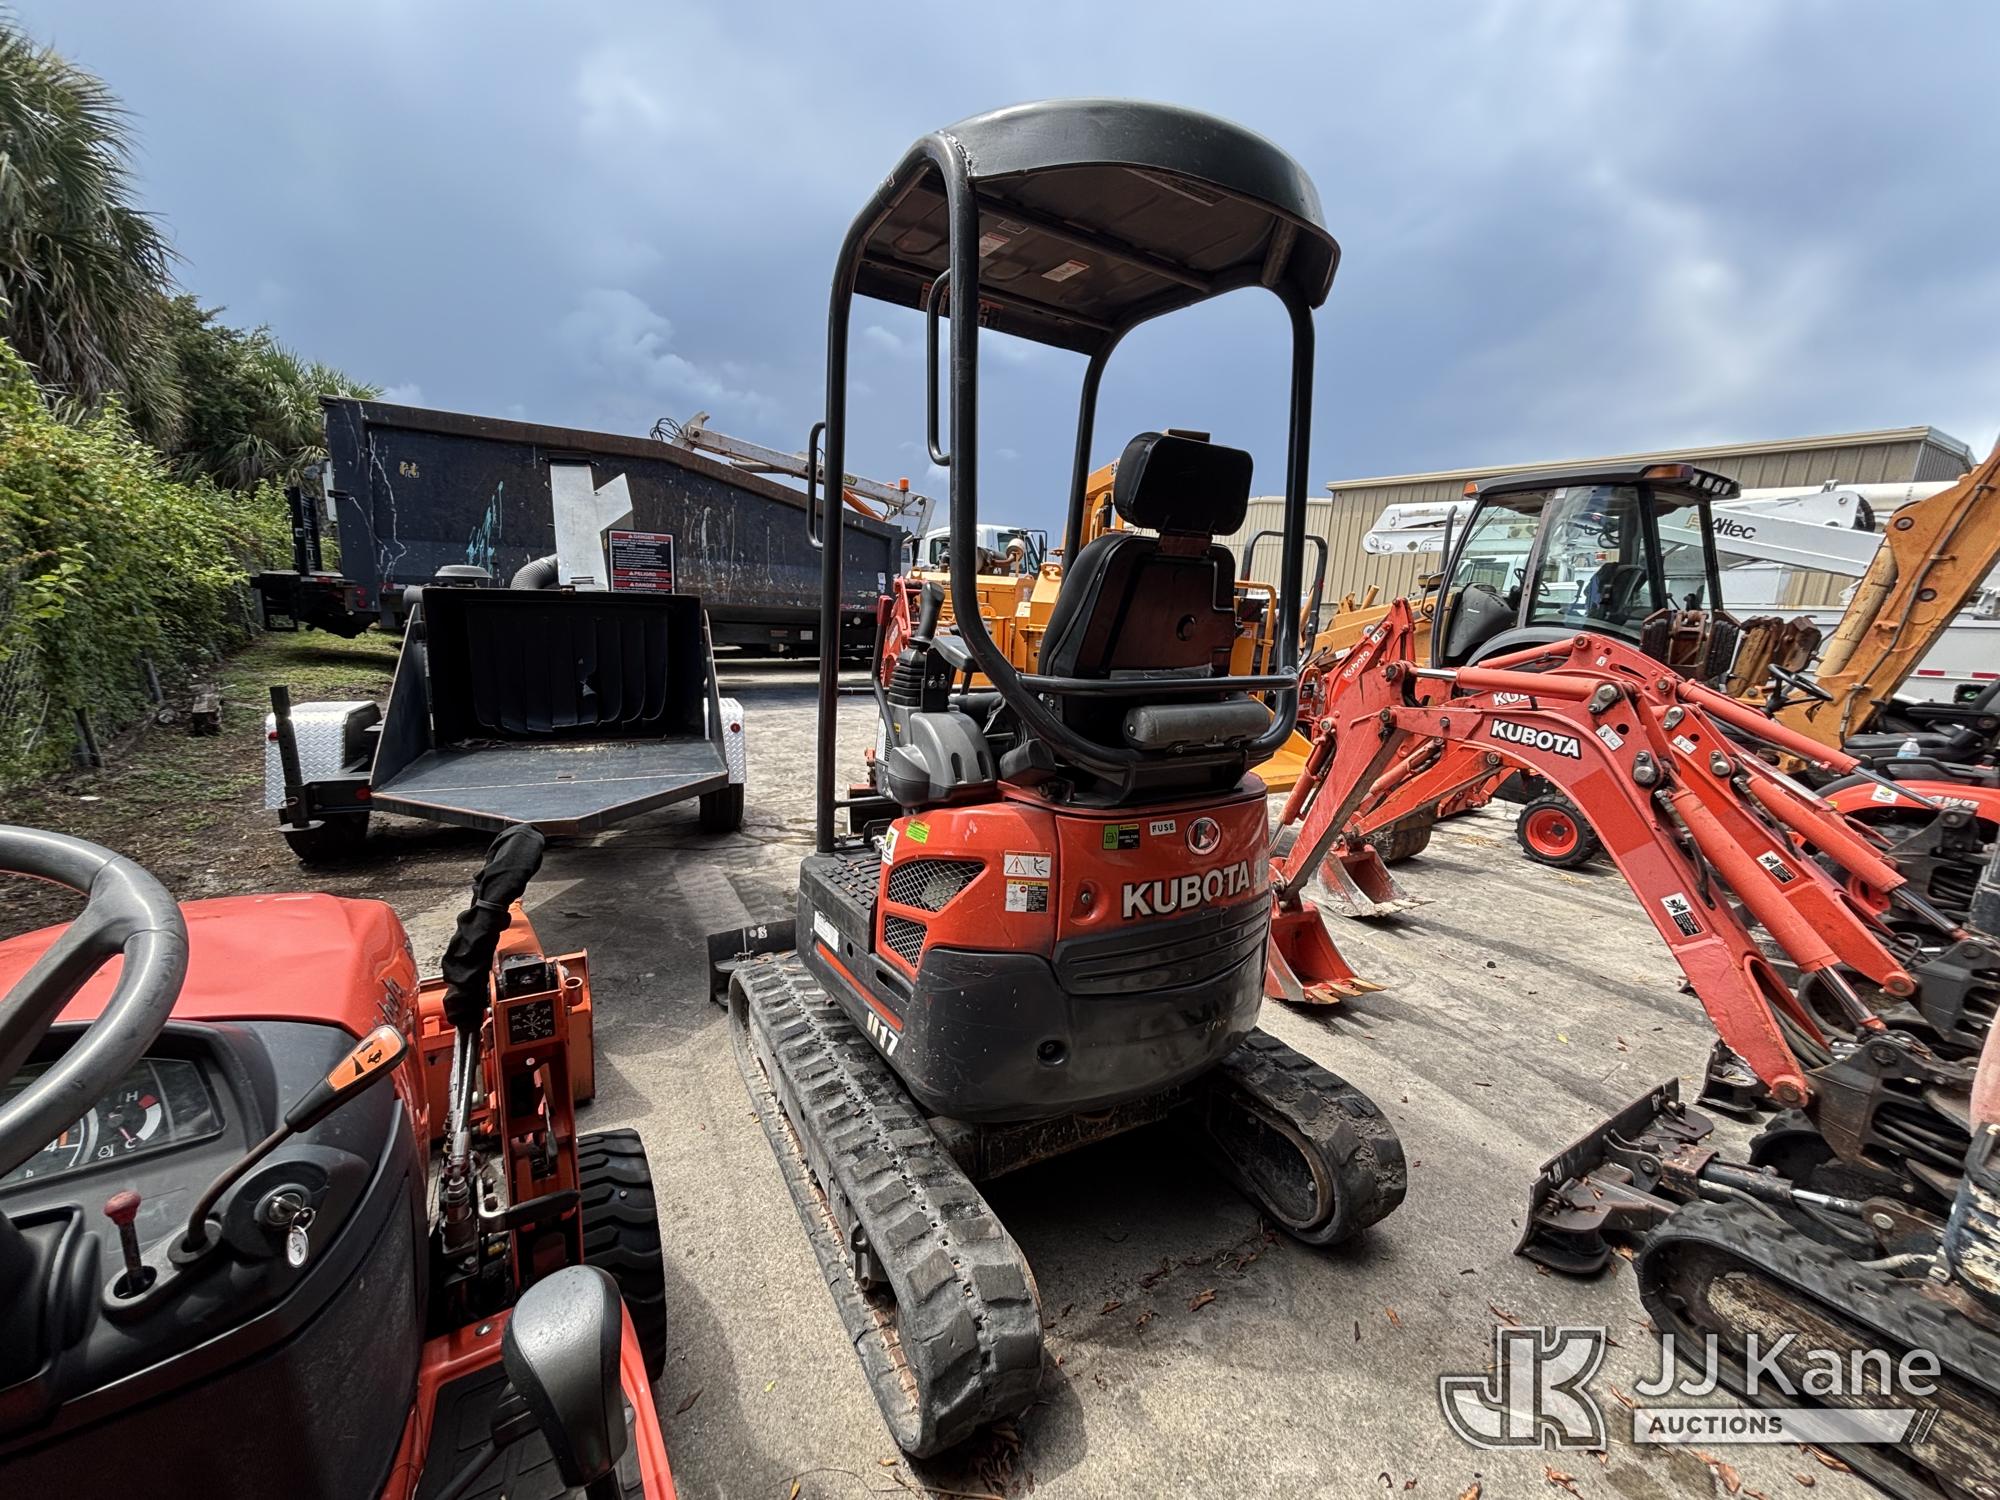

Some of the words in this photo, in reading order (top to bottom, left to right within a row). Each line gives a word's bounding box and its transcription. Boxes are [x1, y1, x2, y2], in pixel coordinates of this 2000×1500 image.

[1712, 517, 1757, 540] Altec
[1342, 650, 1371, 679] Kubota
[1490, 719, 1582, 760] KUBOTA
[1151, 822, 1175, 833] FUSE
[1122, 859, 1251, 919] KUBOTA
[126, 1090, 139, 1103] H
